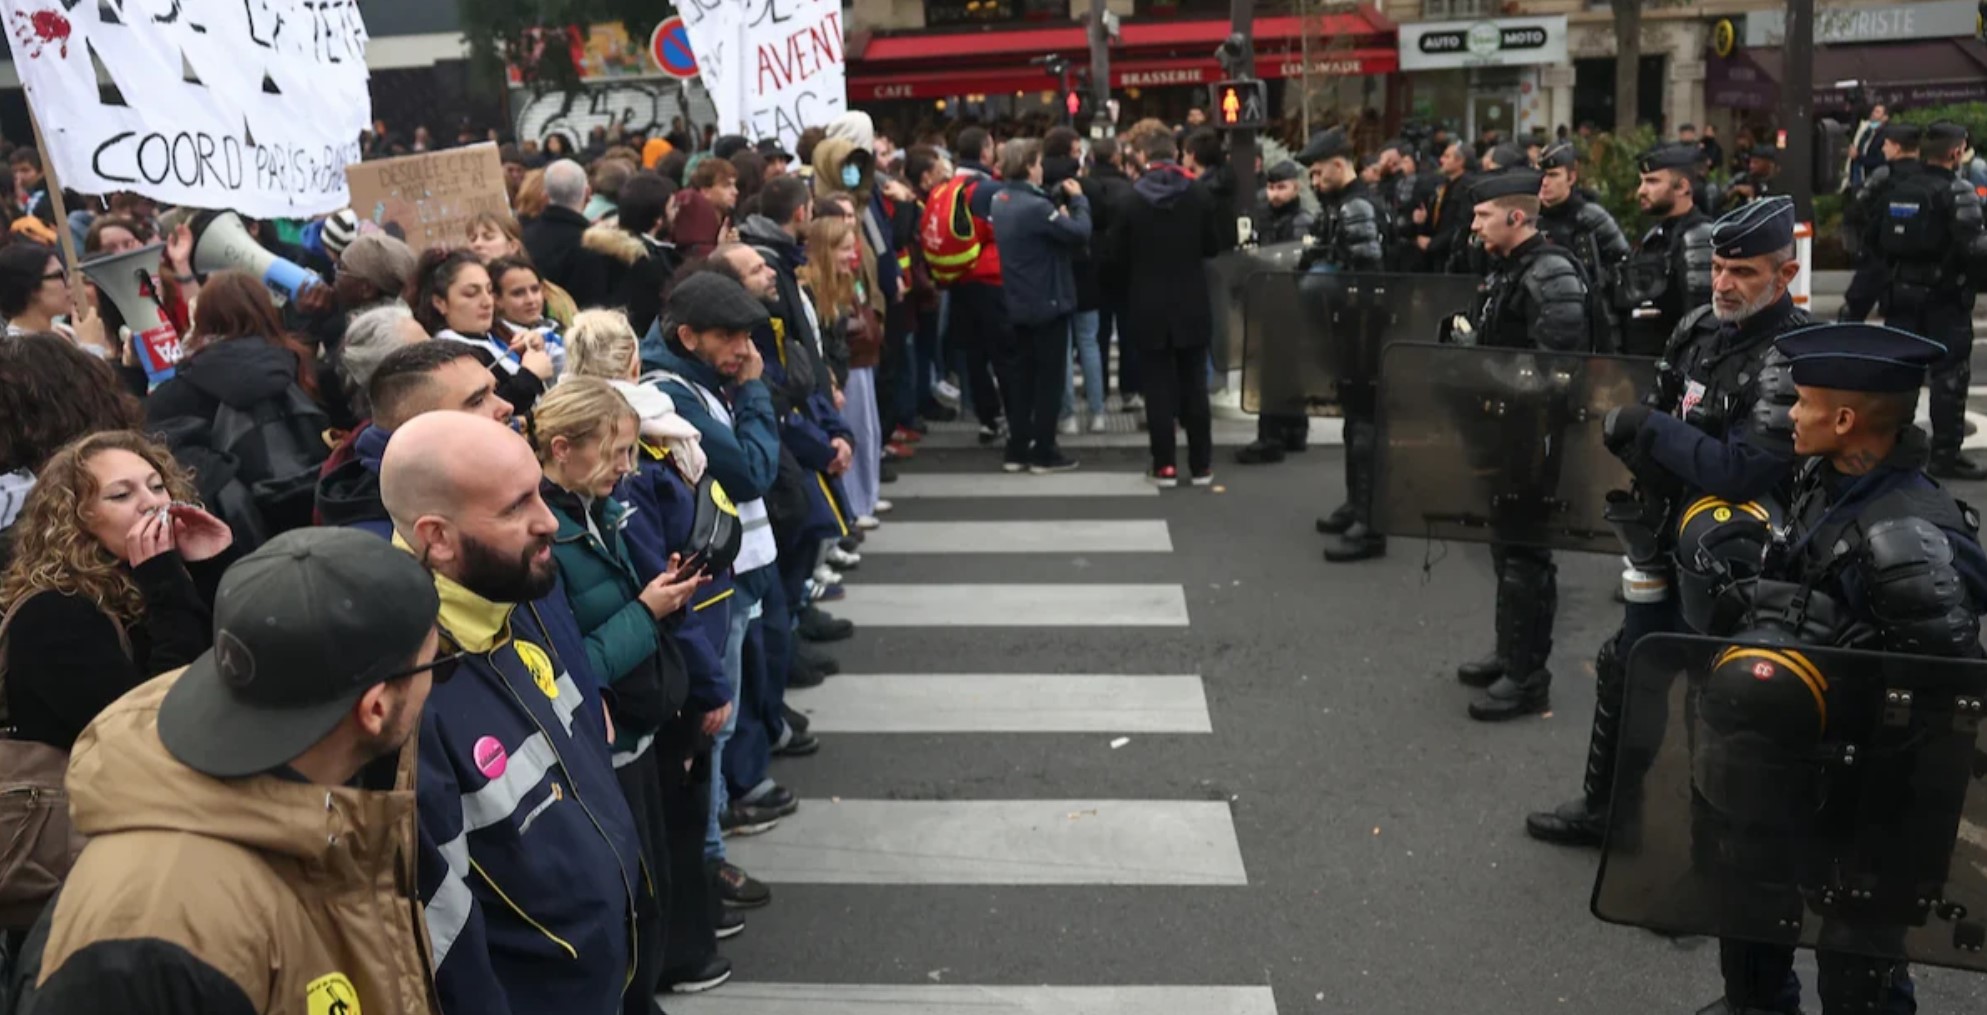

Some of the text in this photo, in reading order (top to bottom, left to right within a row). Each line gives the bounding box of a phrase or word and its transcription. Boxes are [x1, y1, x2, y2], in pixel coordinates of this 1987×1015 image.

[1423, 35, 1460, 49] AUTO
[1504, 30, 1543, 45] MOTO
[1120, 68, 1202, 86] BRASSERIE
[92, 131, 242, 190] COORD
